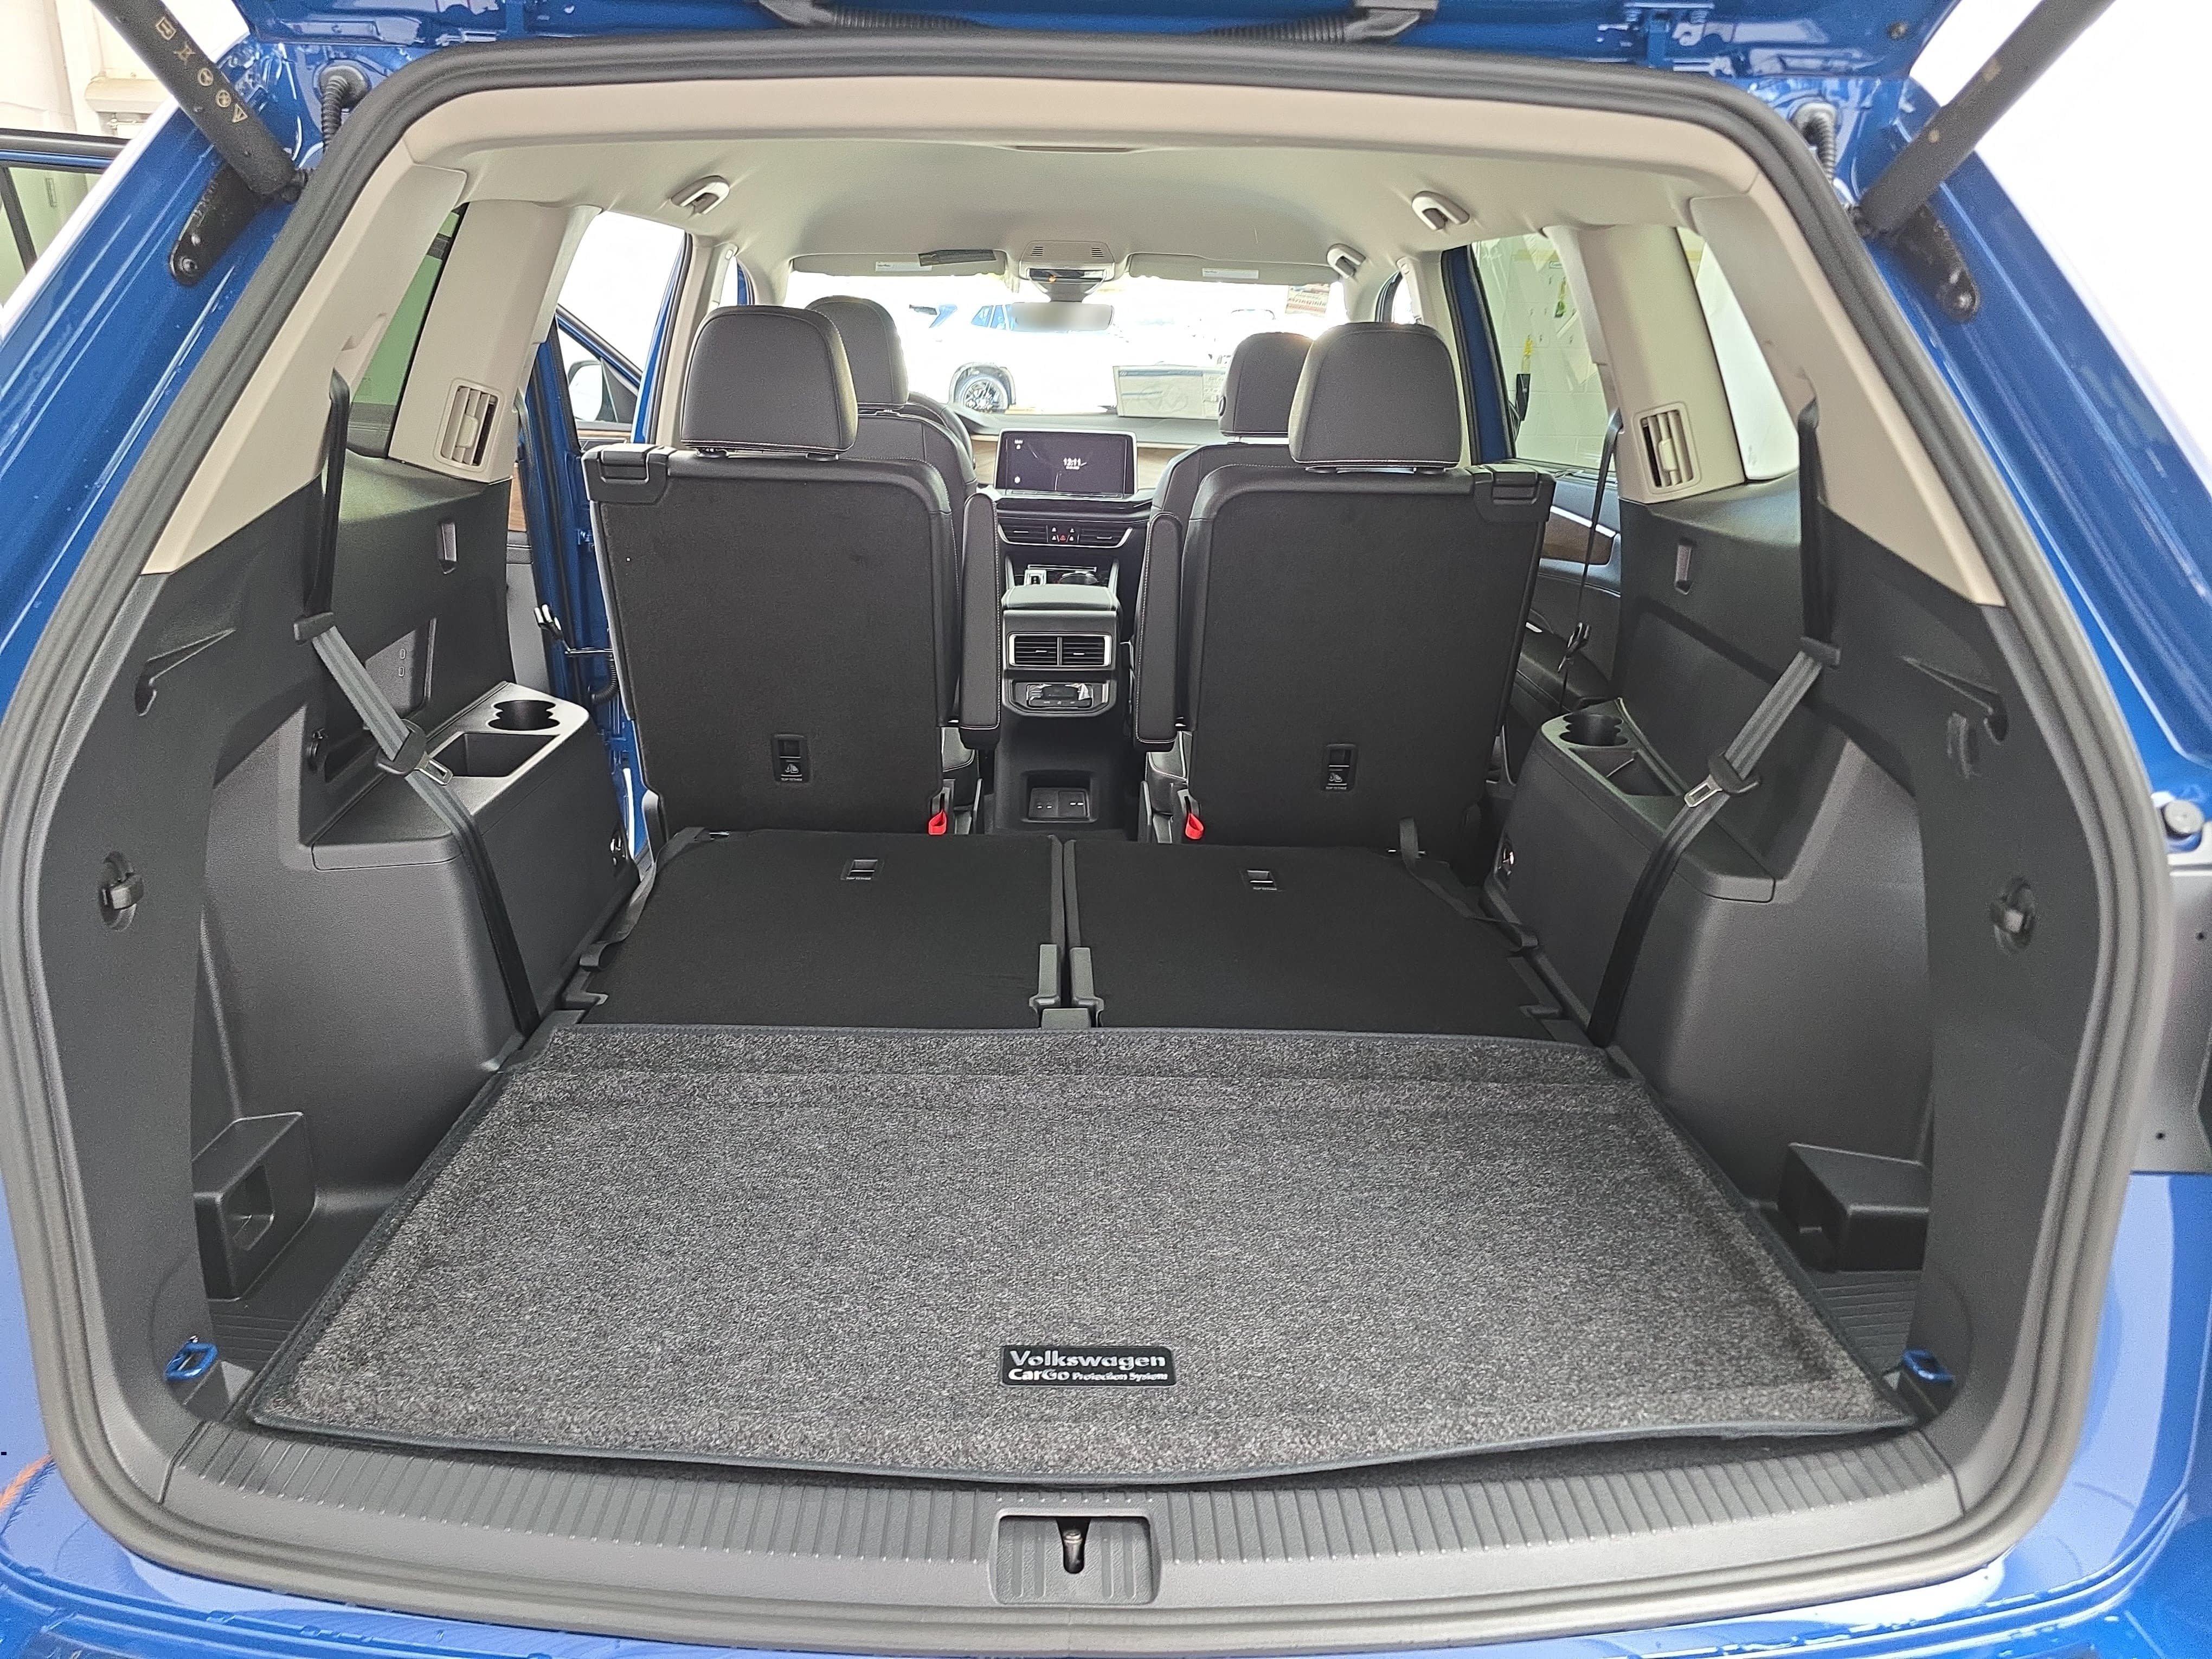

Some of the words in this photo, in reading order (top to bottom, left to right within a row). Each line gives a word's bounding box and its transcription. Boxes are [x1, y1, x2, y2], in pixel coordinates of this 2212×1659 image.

[1063, 458, 1081, 466] 12:11
[1009, 1350, 1166, 1370] Volkswagen
[1072, 1372, 1128, 1381] Protection
